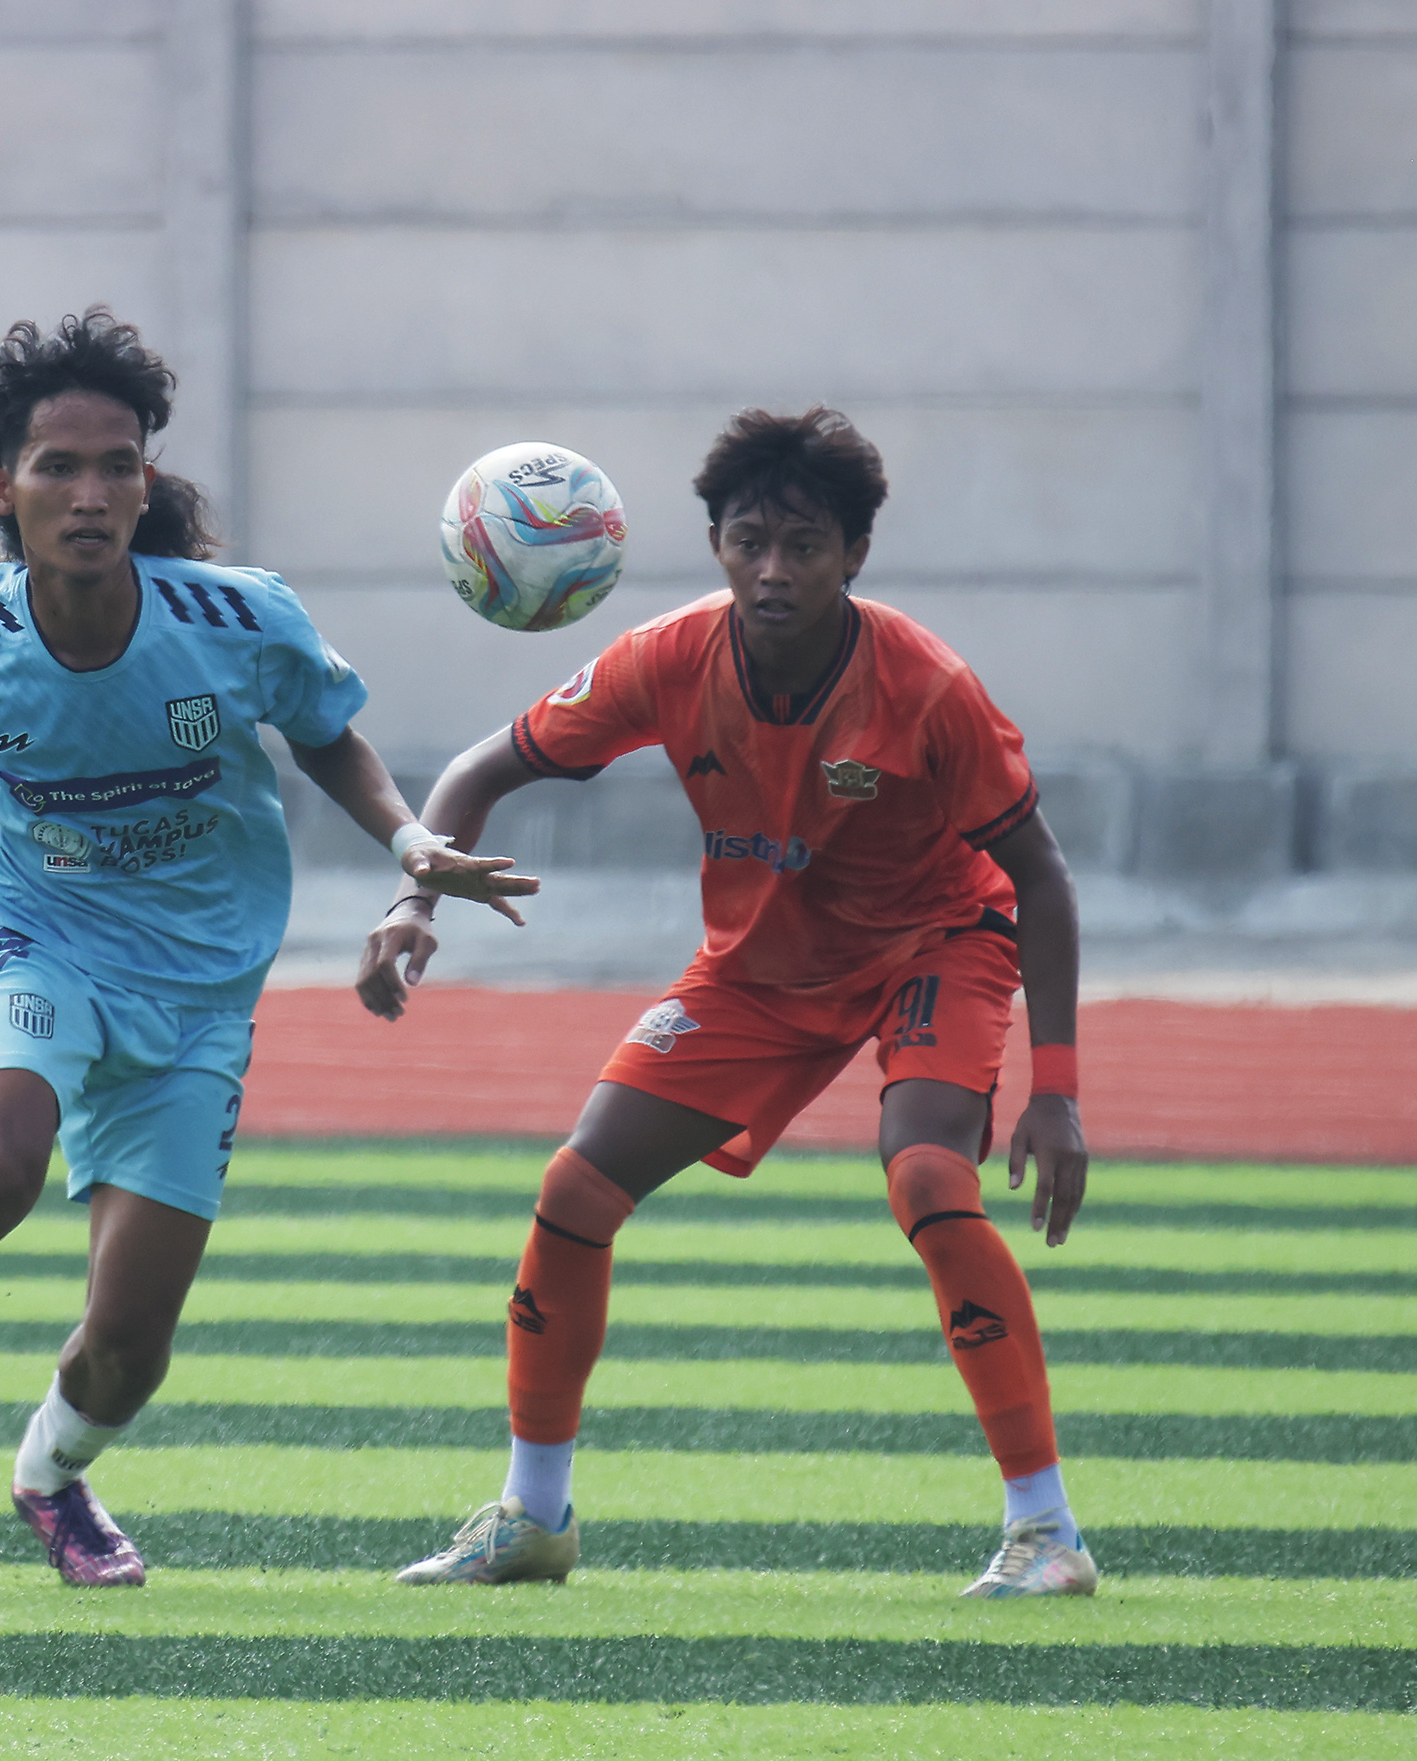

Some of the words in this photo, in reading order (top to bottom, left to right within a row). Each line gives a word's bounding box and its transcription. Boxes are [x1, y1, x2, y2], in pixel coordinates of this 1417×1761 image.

[508, 452, 568, 484] SPECS
[170, 697, 214, 721] UNSA
[49, 791, 85, 802] The
[91, 782, 142, 801] Spirit
[148, 781, 167, 790] of
[173, 769, 215, 791] Java
[47, 855, 88, 868] unsa
[894, 974, 940, 1034] 91
